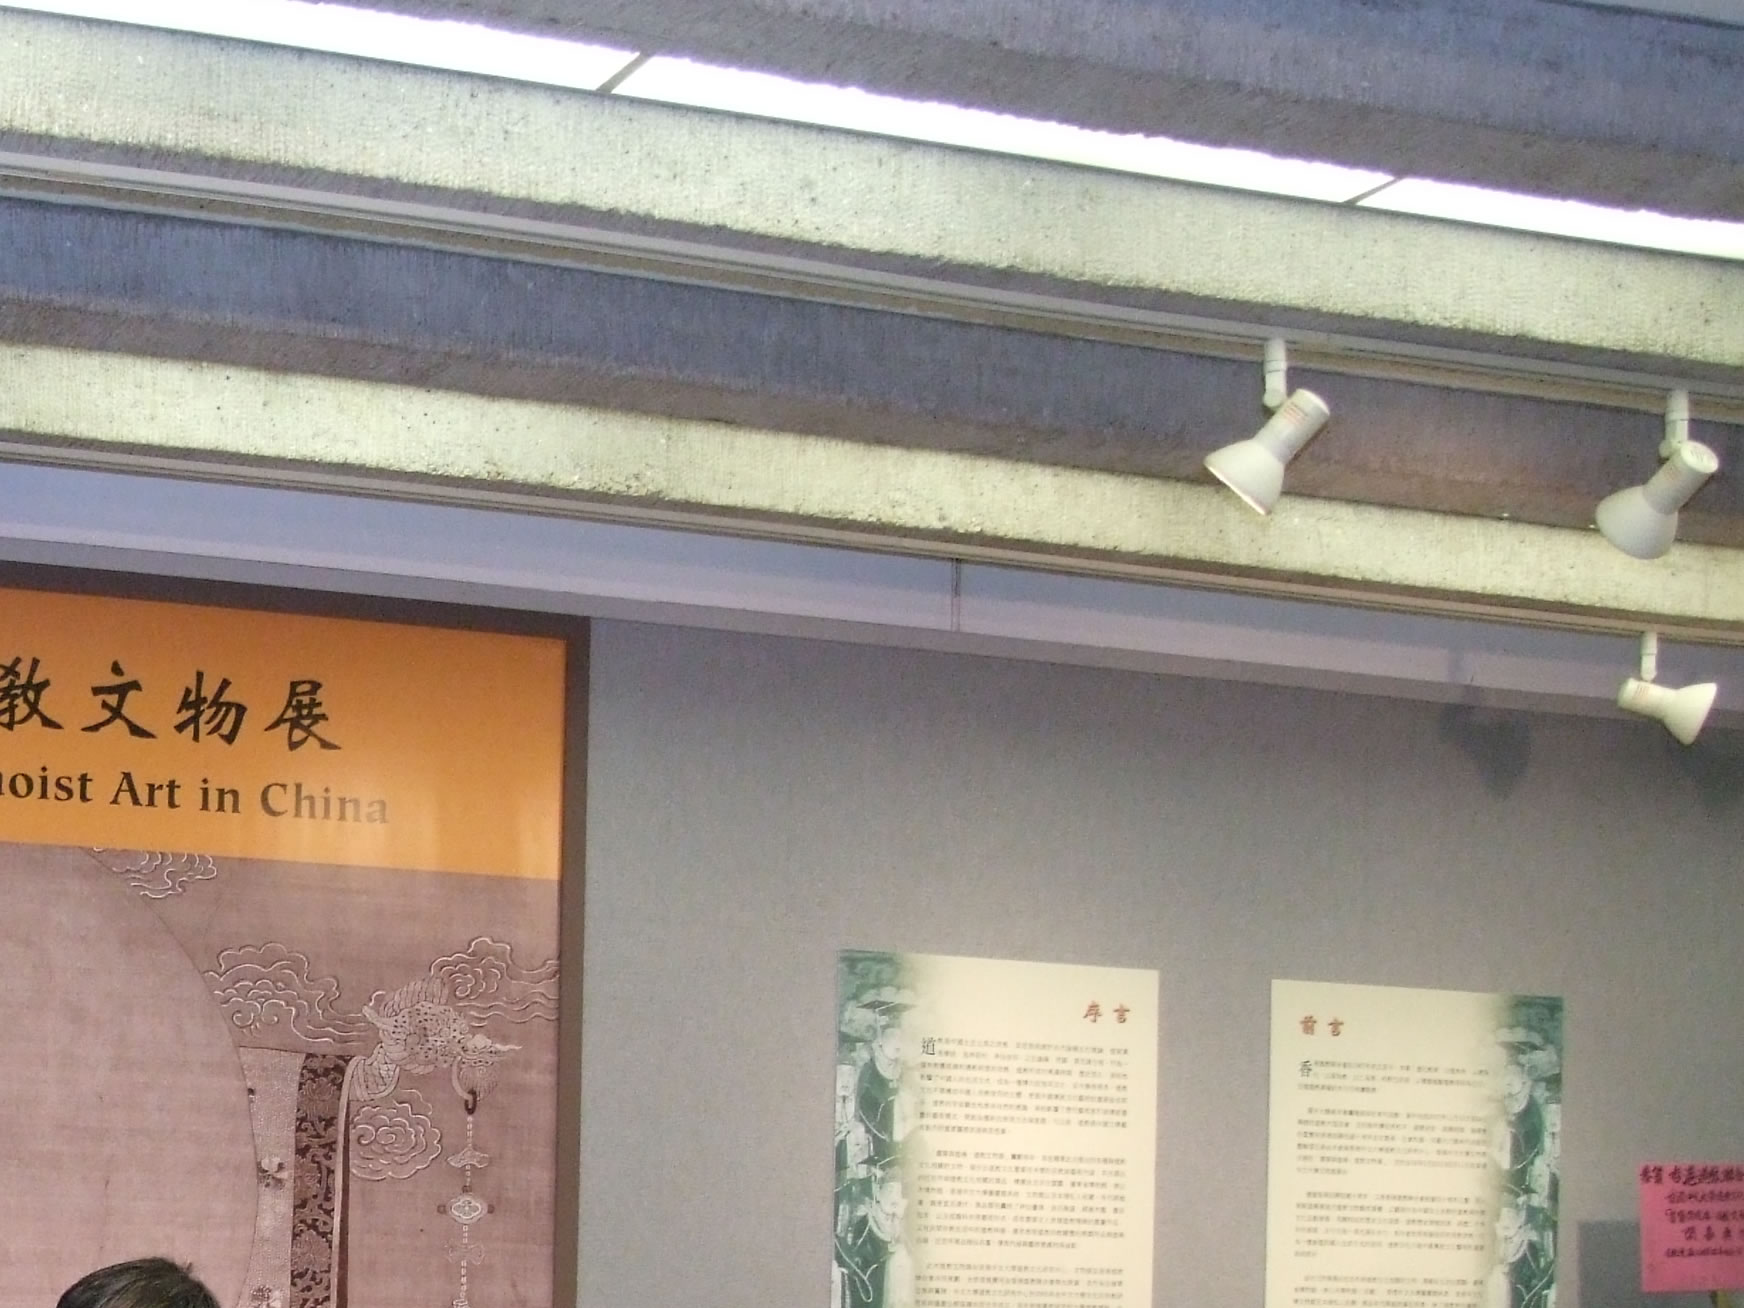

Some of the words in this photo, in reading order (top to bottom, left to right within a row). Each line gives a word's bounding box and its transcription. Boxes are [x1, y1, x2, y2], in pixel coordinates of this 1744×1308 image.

[109, 771, 182, 811] Art
[199, 778, 241, 815] in
[259, 783, 390, 825] China
